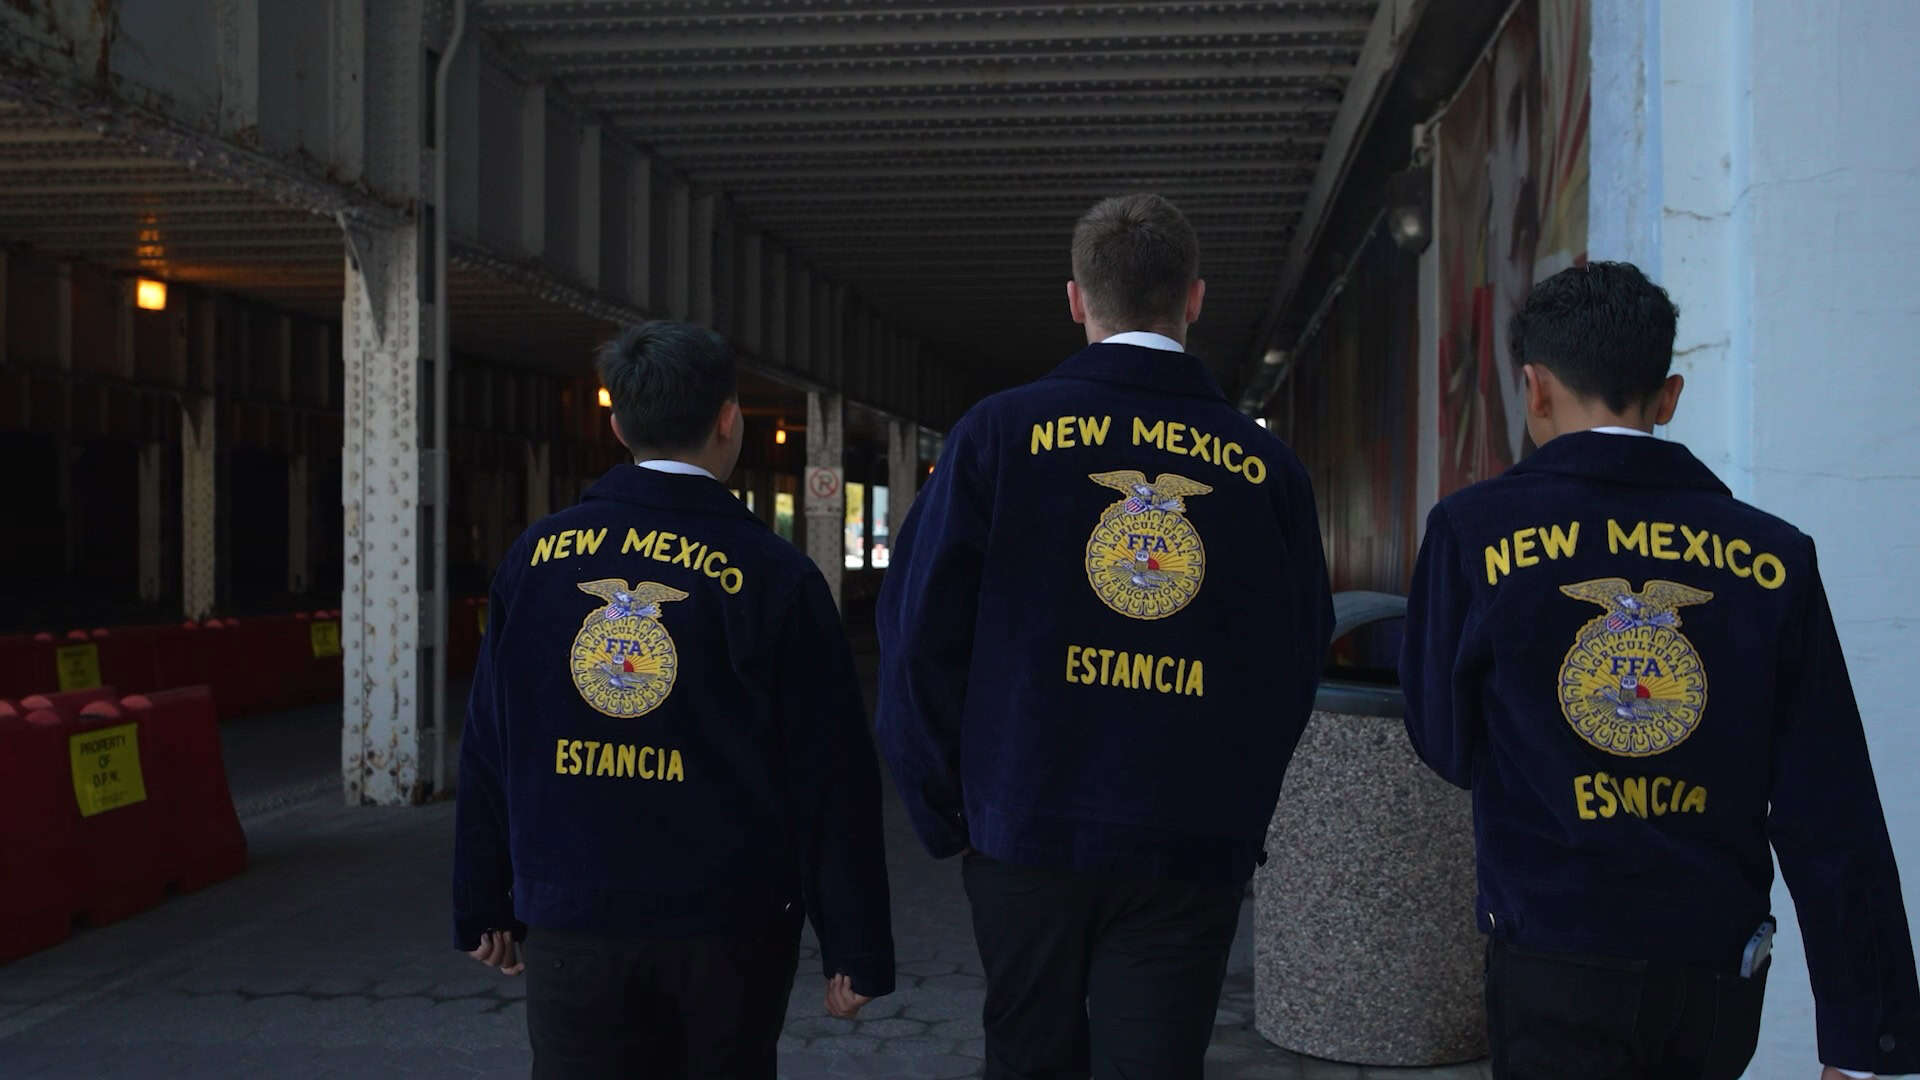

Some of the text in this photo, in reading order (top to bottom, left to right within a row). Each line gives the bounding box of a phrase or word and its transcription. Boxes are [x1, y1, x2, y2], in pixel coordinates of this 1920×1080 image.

[1031, 415, 1267, 485] NEW MEXICO
[1107, 522, 1185, 556] AGRICULTURAL
[1127, 533, 1169, 553] FFA
[530, 527, 744, 594] NEW MEXICO
[1484, 519, 1787, 590] NEW MEXICO
[1111, 577, 1178, 600] EDUCATION
[605, 638, 643, 656] FFA
[1586, 640, 1683, 682] AGRICULTURAL
[1066, 645, 1205, 697] ESTANCIA
[1610, 655, 1662, 677] FFA
[1591, 708, 1677, 735] EDUCATION
[80, 736, 127, 755] PROPERTY
[98, 753, 111, 768] OF
[555, 739, 684, 782] ESTANCIA
